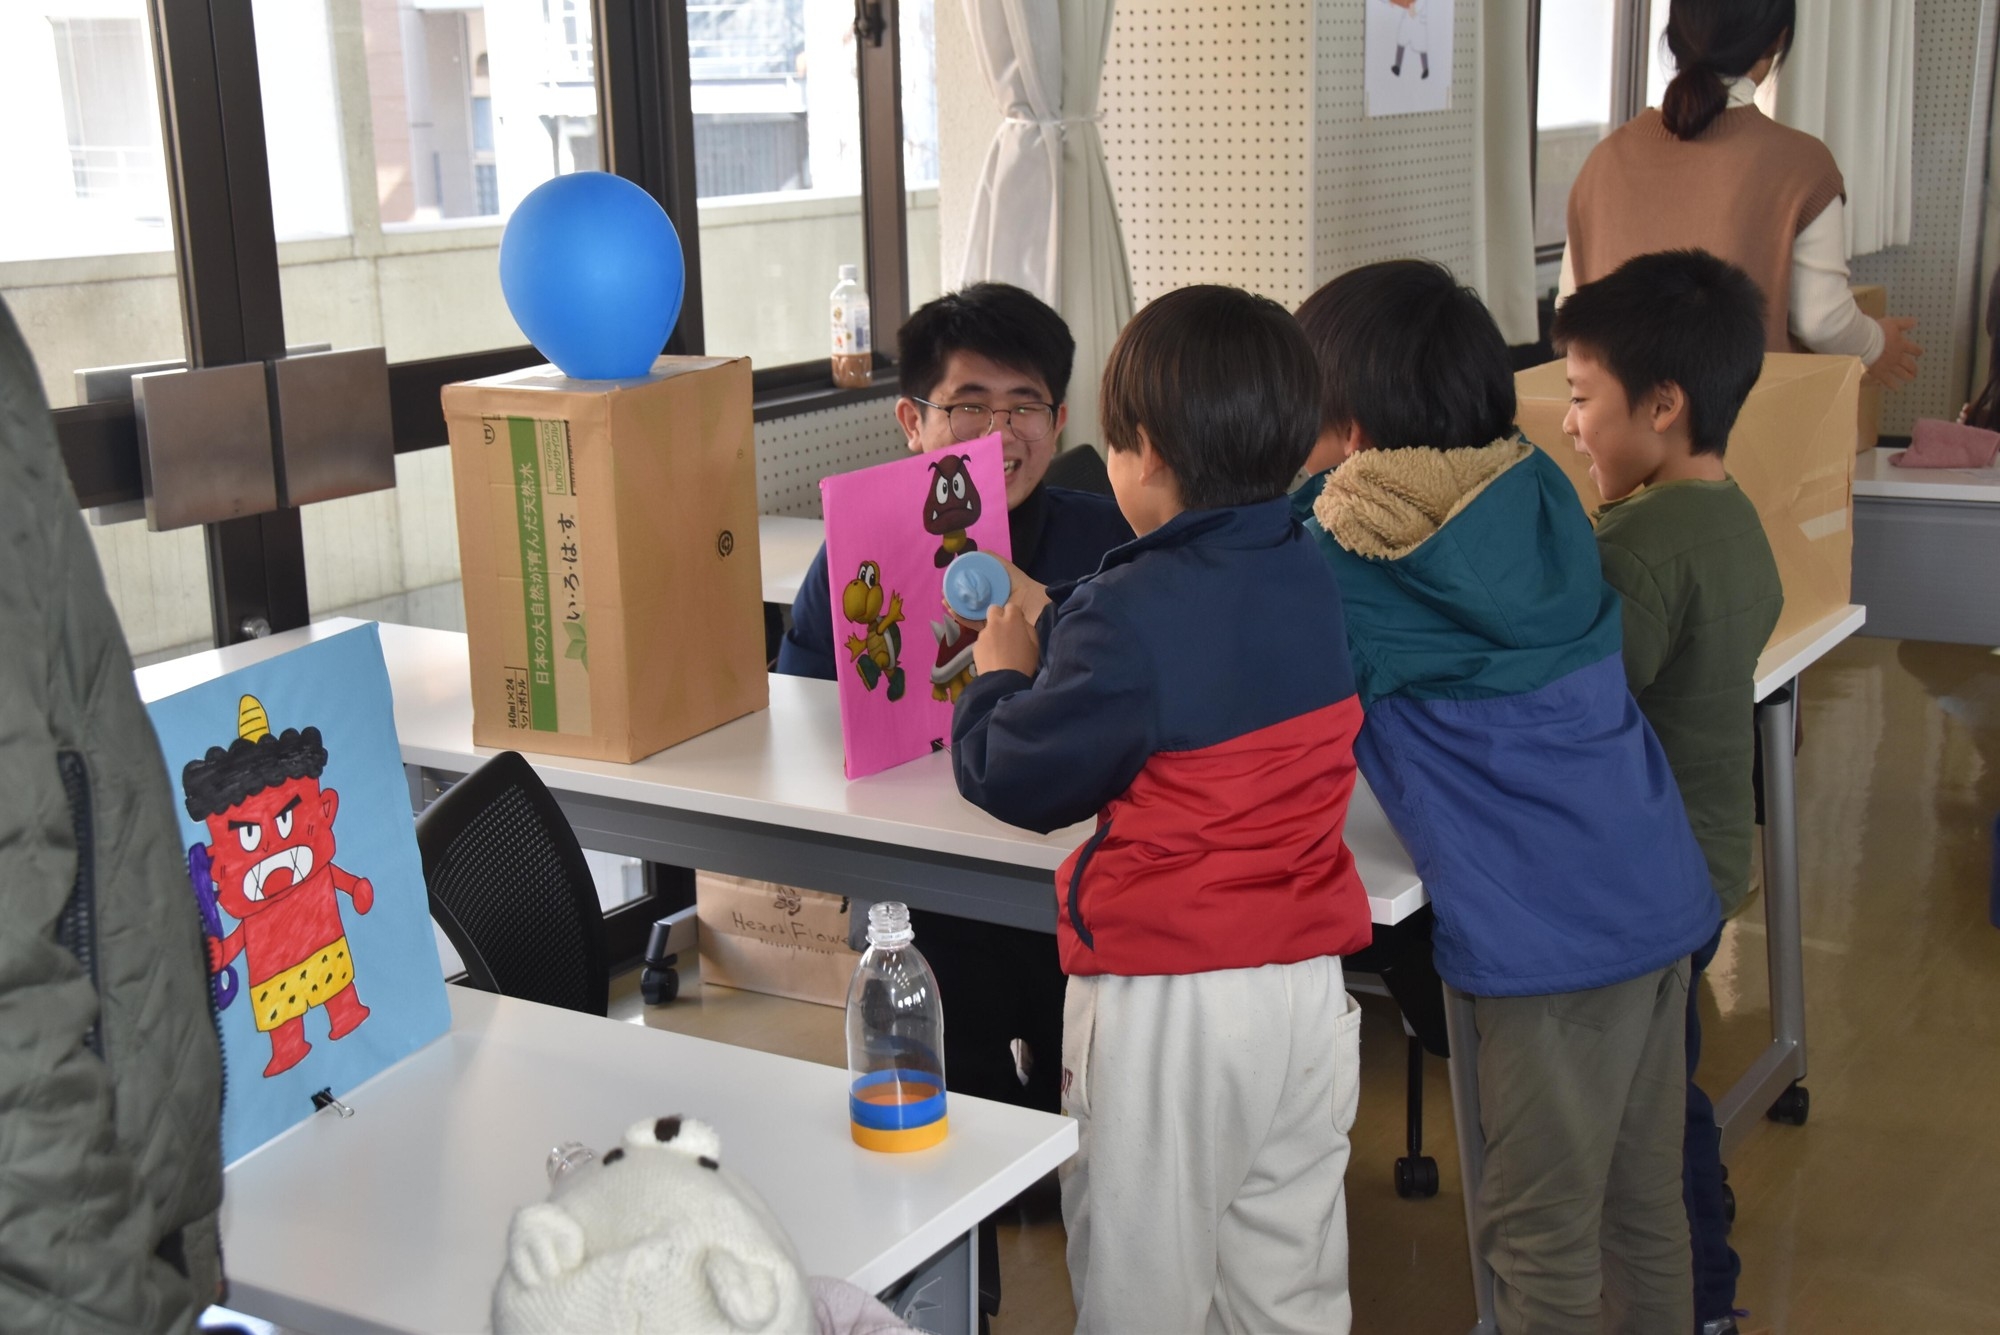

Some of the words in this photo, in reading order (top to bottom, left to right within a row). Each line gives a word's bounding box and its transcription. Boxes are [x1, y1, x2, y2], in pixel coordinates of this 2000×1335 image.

[519, 461, 550, 684] 日本の大自然が育んだ天然水
[732, 911, 785, 934] Heart
